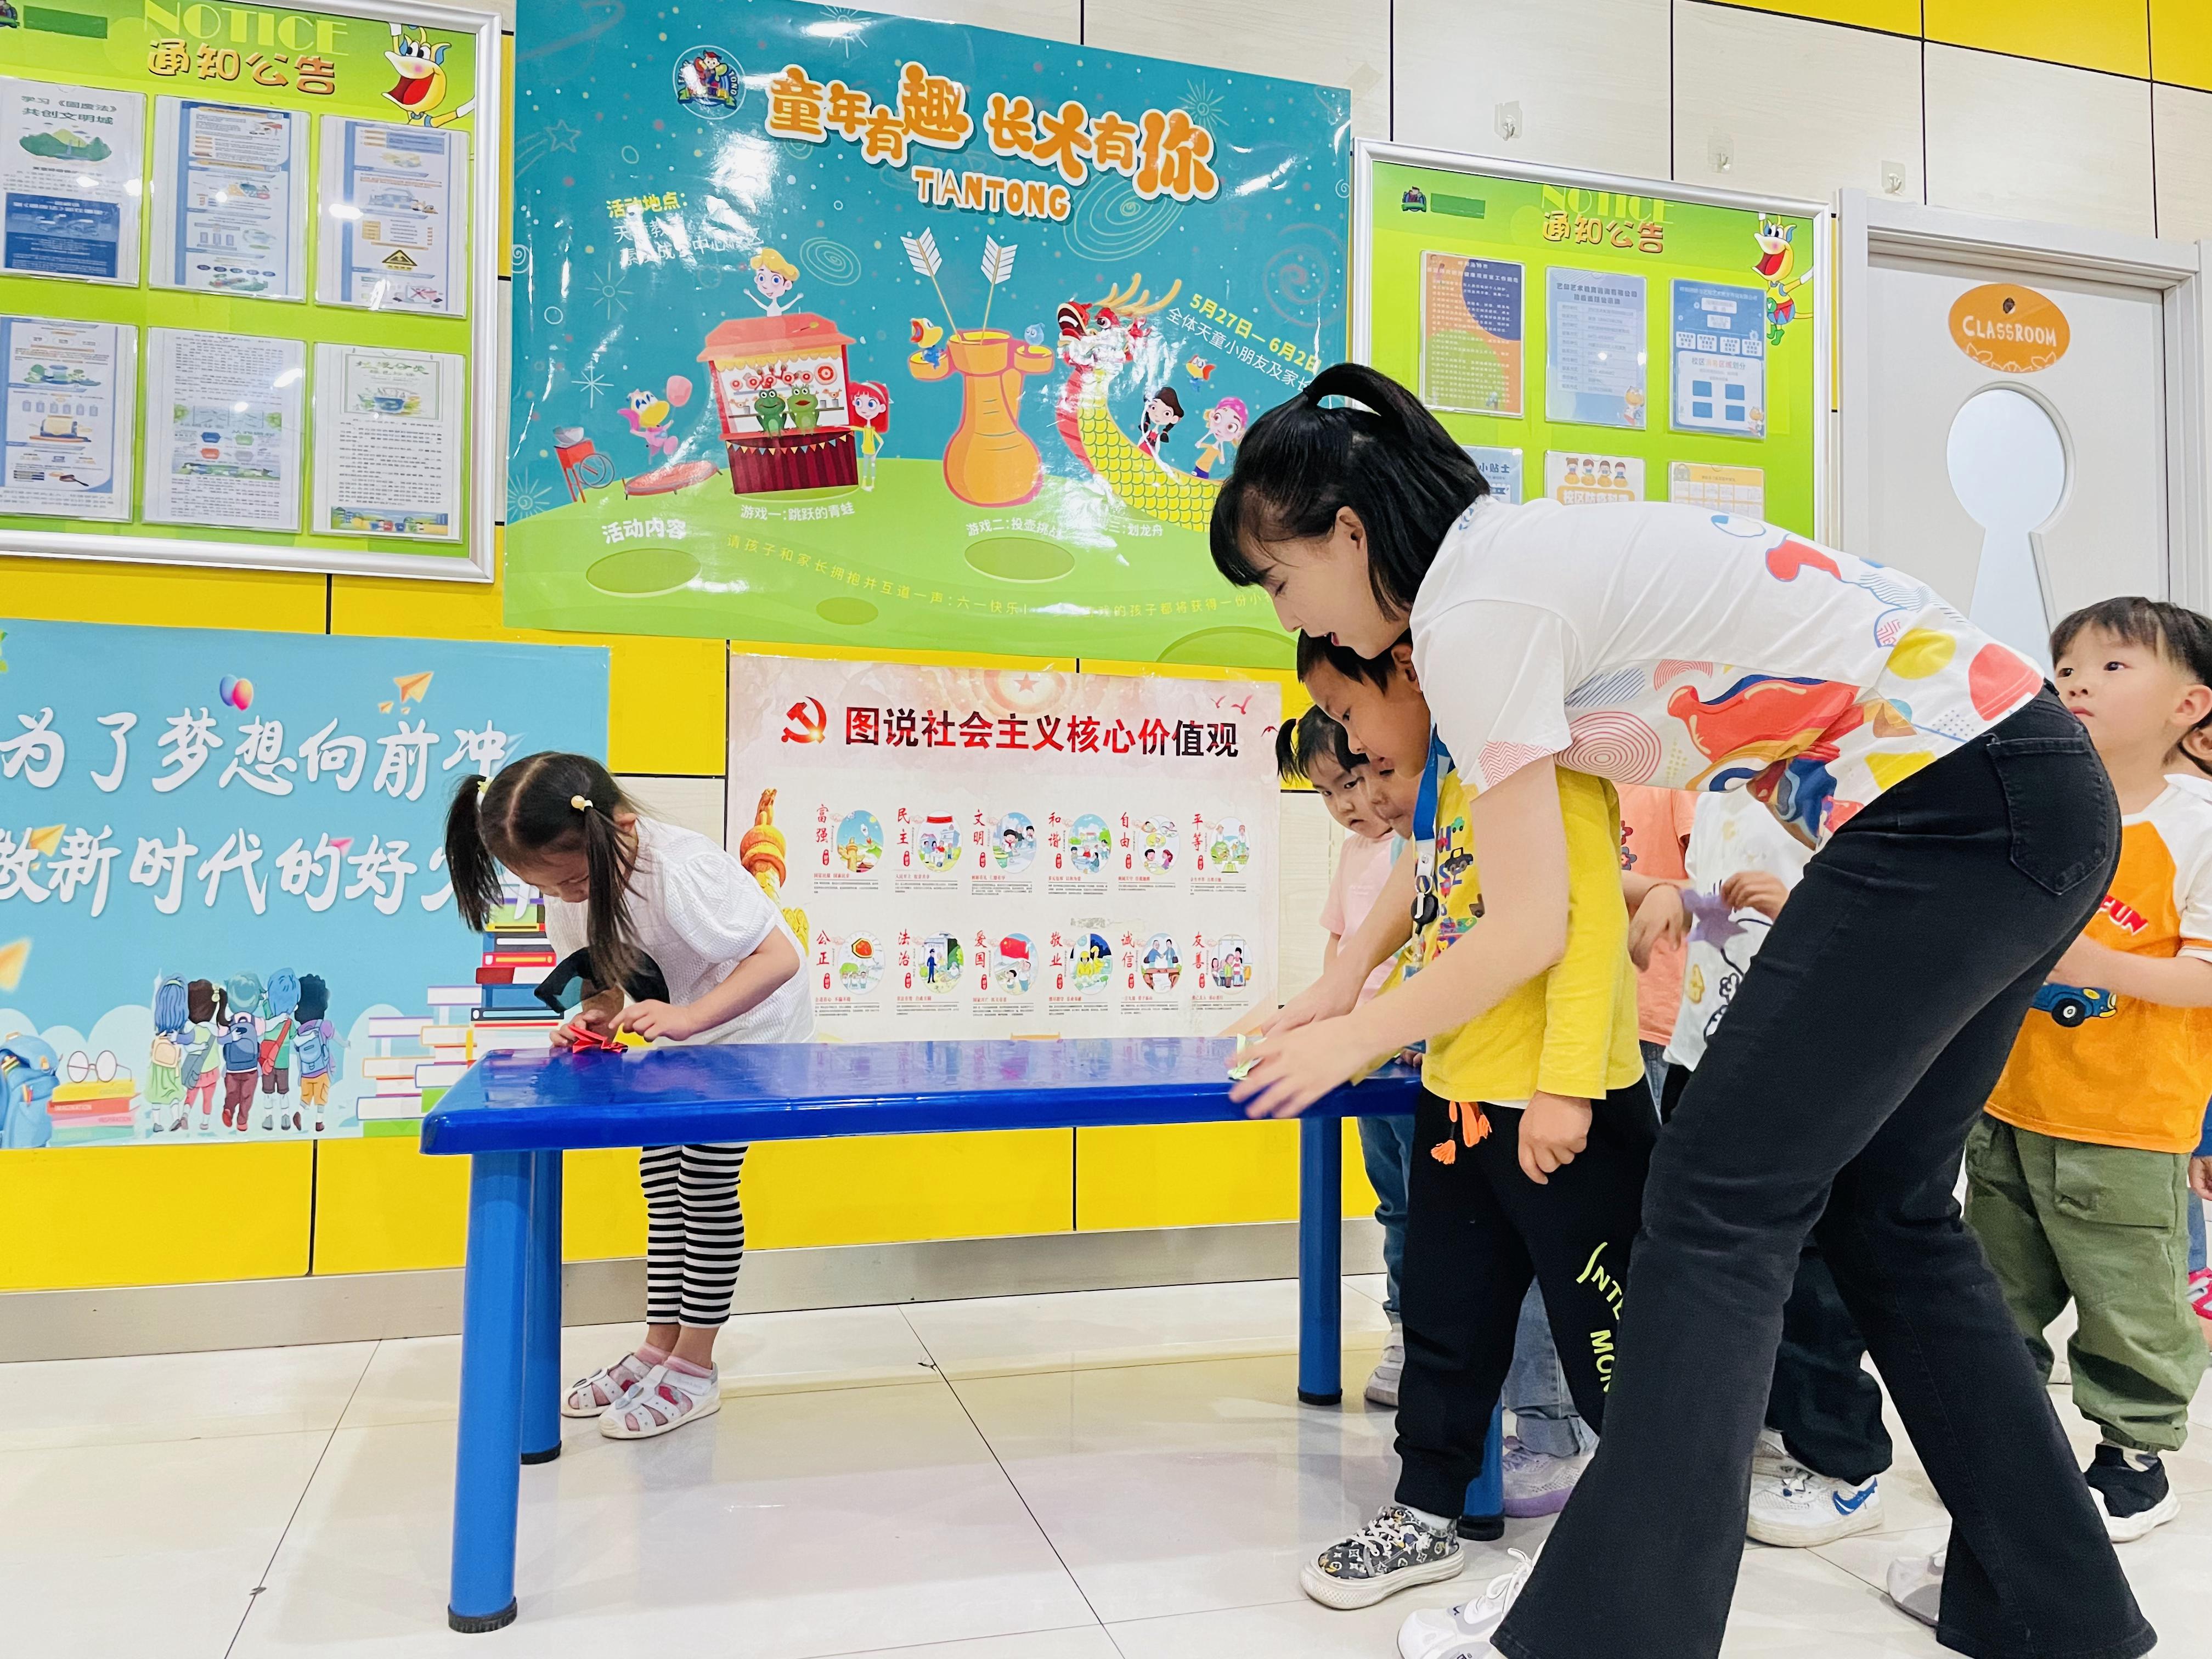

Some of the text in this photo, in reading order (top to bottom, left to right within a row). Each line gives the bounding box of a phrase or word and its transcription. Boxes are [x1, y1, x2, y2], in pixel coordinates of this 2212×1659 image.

[145, 0, 349, 56] NOTICE
[148, 38, 335, 95] 通知公告
[768, 63, 1216, 195] 童年有趣 长大有你
[915, 169, 1069, 219] TIANTONG
[1542, 184, 1674, 224] NOTICE
[1543, 210, 1663, 254] 通知公告
[1962, 315, 2057, 347] CLASSROOM
[601, 517, 687, 544] 活动内容
[741, 502, 855, 521] 游戏一:跳跃的青蛙
[845, 706, 1239, 758] 图说社会主义核心价值观
[0, 707, 507, 801] 为了梦想向前冲
[816, 804, 830, 843] 富强
[897, 808, 911, 845] 民主
[973, 809, 986, 847] 文明
[1048, 811, 1062, 849] 和谐
[1120, 811, 1131, 849] 自由
[1192, 814, 1203, 851] 平等
[0, 823, 531, 919] 做新时代的好
[816, 929, 831, 966] 公正
[898, 928, 911, 967] 法治
[974, 930, 988, 968] 爱国
[1049, 932, 1063, 967] 敬业
[1121, 930, 1136, 968] 诚信
[1192, 931, 1205, 969] 友善
